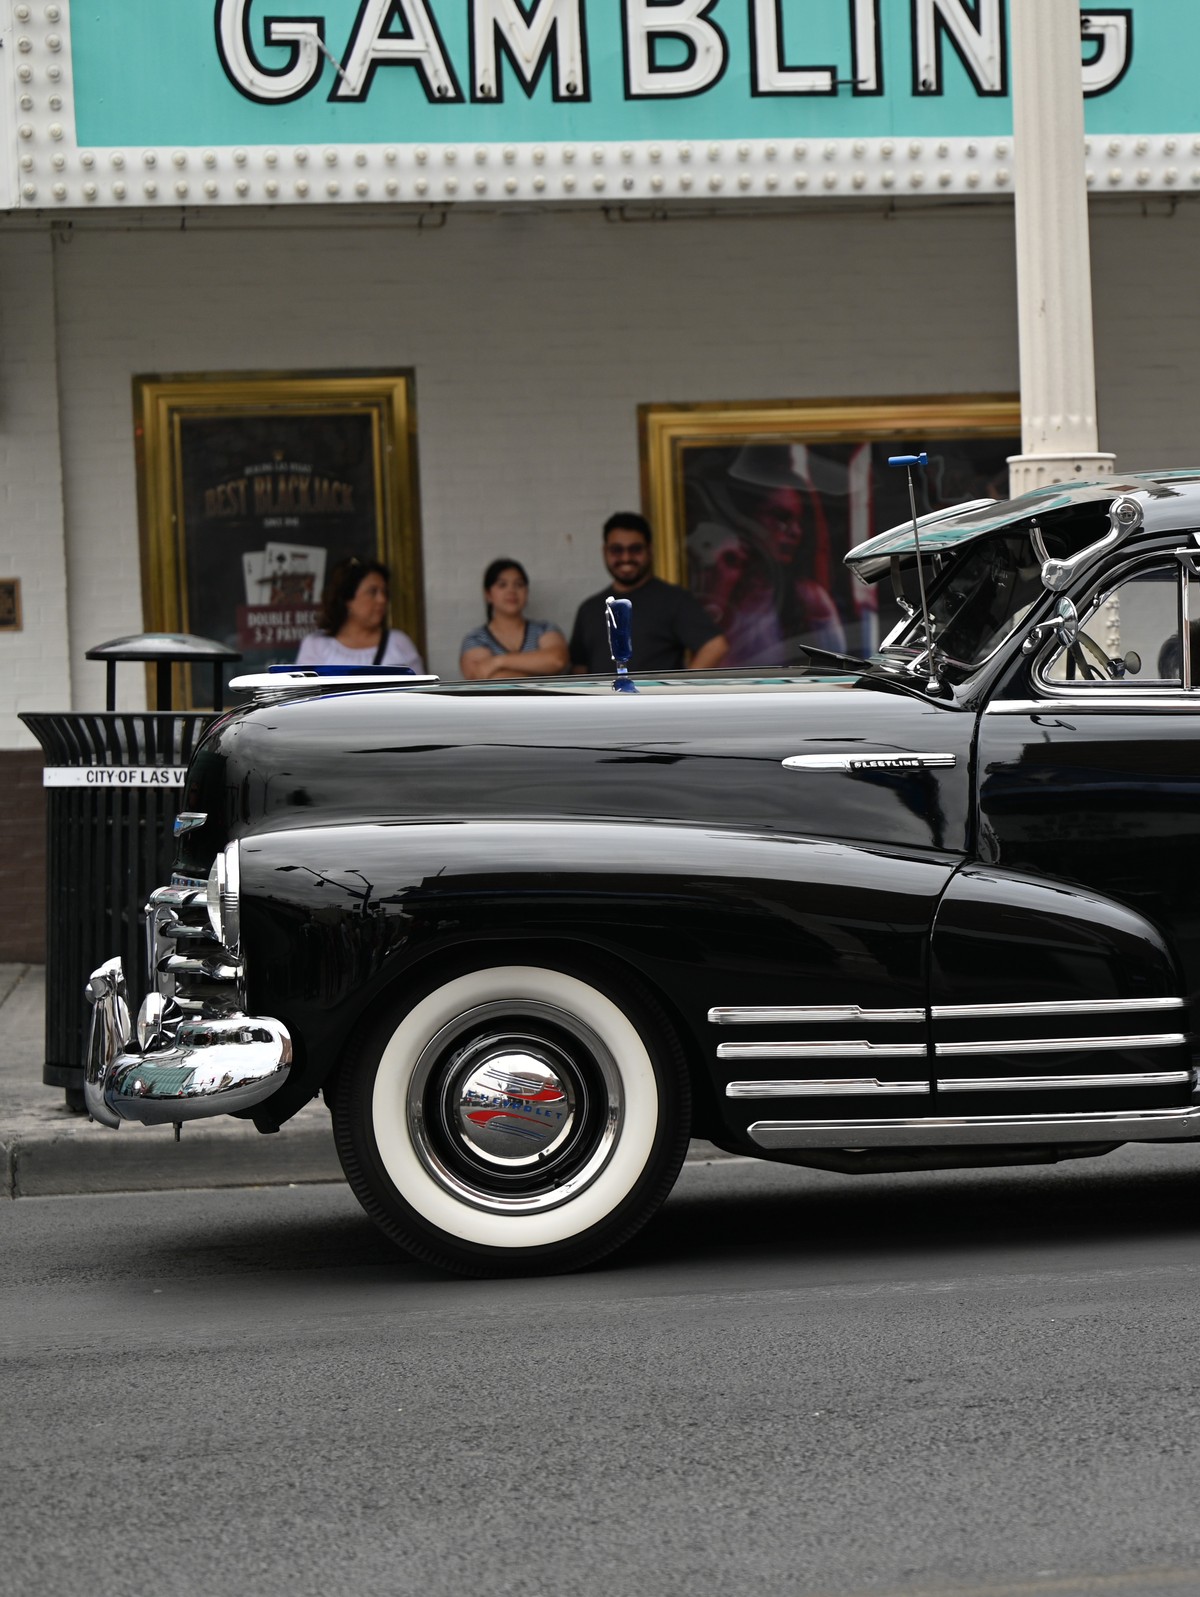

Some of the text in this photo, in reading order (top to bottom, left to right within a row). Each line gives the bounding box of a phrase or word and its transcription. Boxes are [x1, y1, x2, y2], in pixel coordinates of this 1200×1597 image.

[214, 0, 1132, 105] GAMBLIN
[205, 479, 248, 517] BEST
[247, 609, 320, 628] DOUBLE DEC
[854, 760, 920, 768] FLEETLINE
[86, 770, 114, 783] CITY
[118, 771, 137, 783] OF
[141, 771, 169, 783] LAS
[467, 1089, 563, 1119] CHEVROLET
